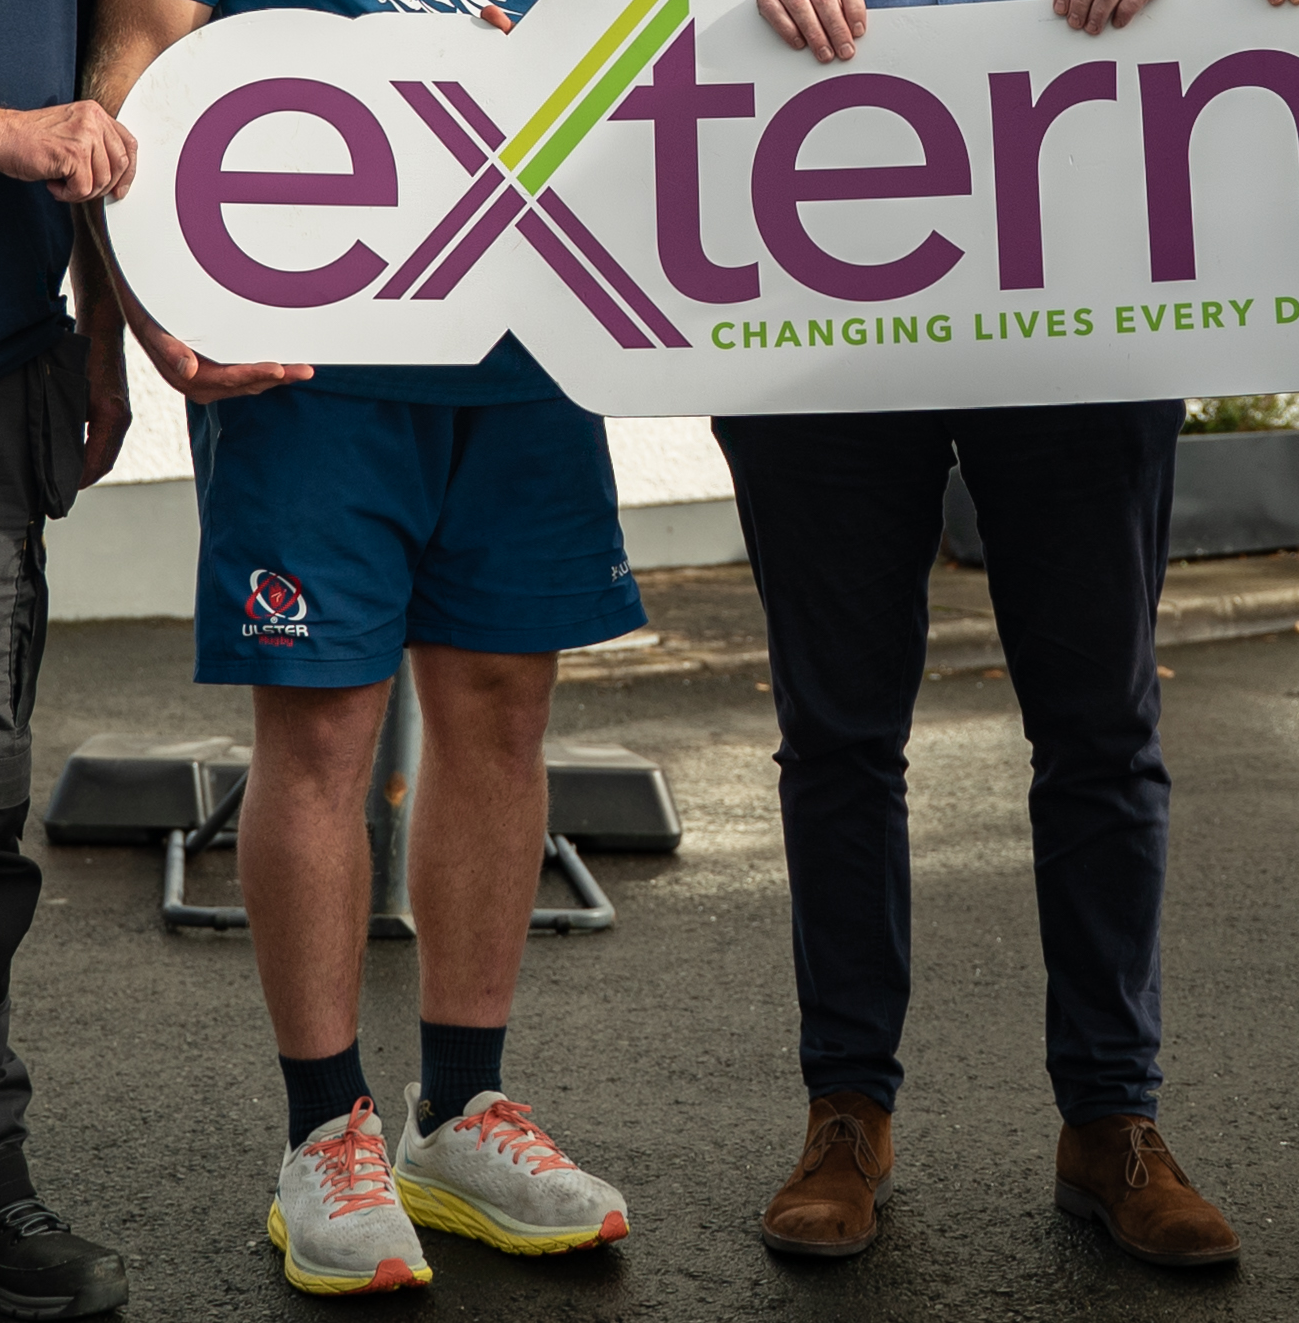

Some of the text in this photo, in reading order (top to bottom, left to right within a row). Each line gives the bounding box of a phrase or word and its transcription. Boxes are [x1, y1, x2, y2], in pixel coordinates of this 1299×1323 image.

[711, 314, 952, 350] CHANGING
[974, 308, 1094, 341] LIVES
[1115, 299, 1255, 334] EVERY
[242, 623, 309, 637] ULSTER
